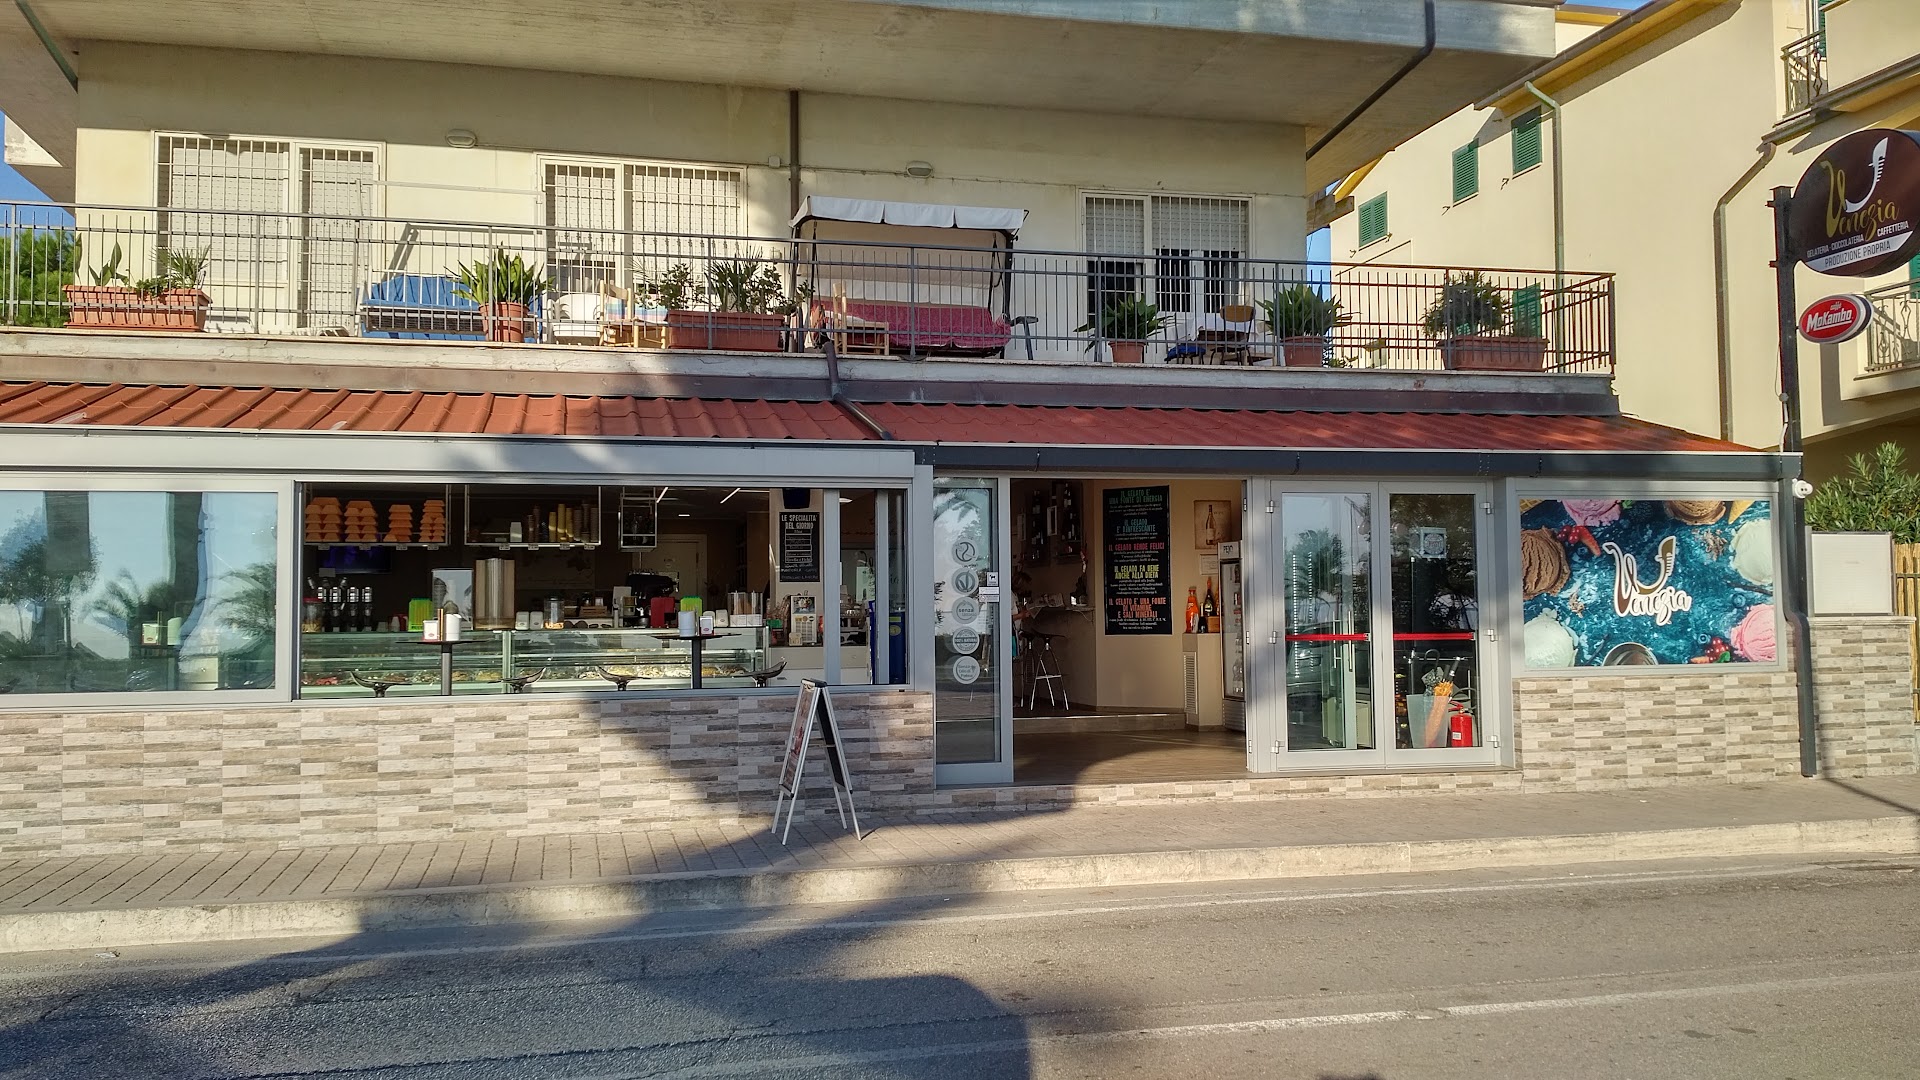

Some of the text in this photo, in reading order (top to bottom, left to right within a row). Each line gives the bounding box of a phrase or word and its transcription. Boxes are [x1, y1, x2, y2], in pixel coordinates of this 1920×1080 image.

[1820, 160, 1900, 242] Venezia
[1806, 244, 1830, 259] GELATERIA
[1876, 220, 1910, 238] CAFFETTERIA
[1824, 240, 1892, 268] PRODUZIONE PROPRIA
[781, 514, 818, 522] LE SPECIALITA'
[785, 522, 814, 530] DEL GIORNO
[1114, 543, 1132, 551] GELATO
[1149, 542, 1165, 550] FELICI
[1120, 564, 1138, 573] GELATO
[1139, 564, 1146, 572] FA
[1131, 571, 1144, 579] ALLA
[1144, 571, 1159, 579] DIETA
[1602, 540, 1692, 626] Venezia
[1115, 597, 1133, 606] GELATO
